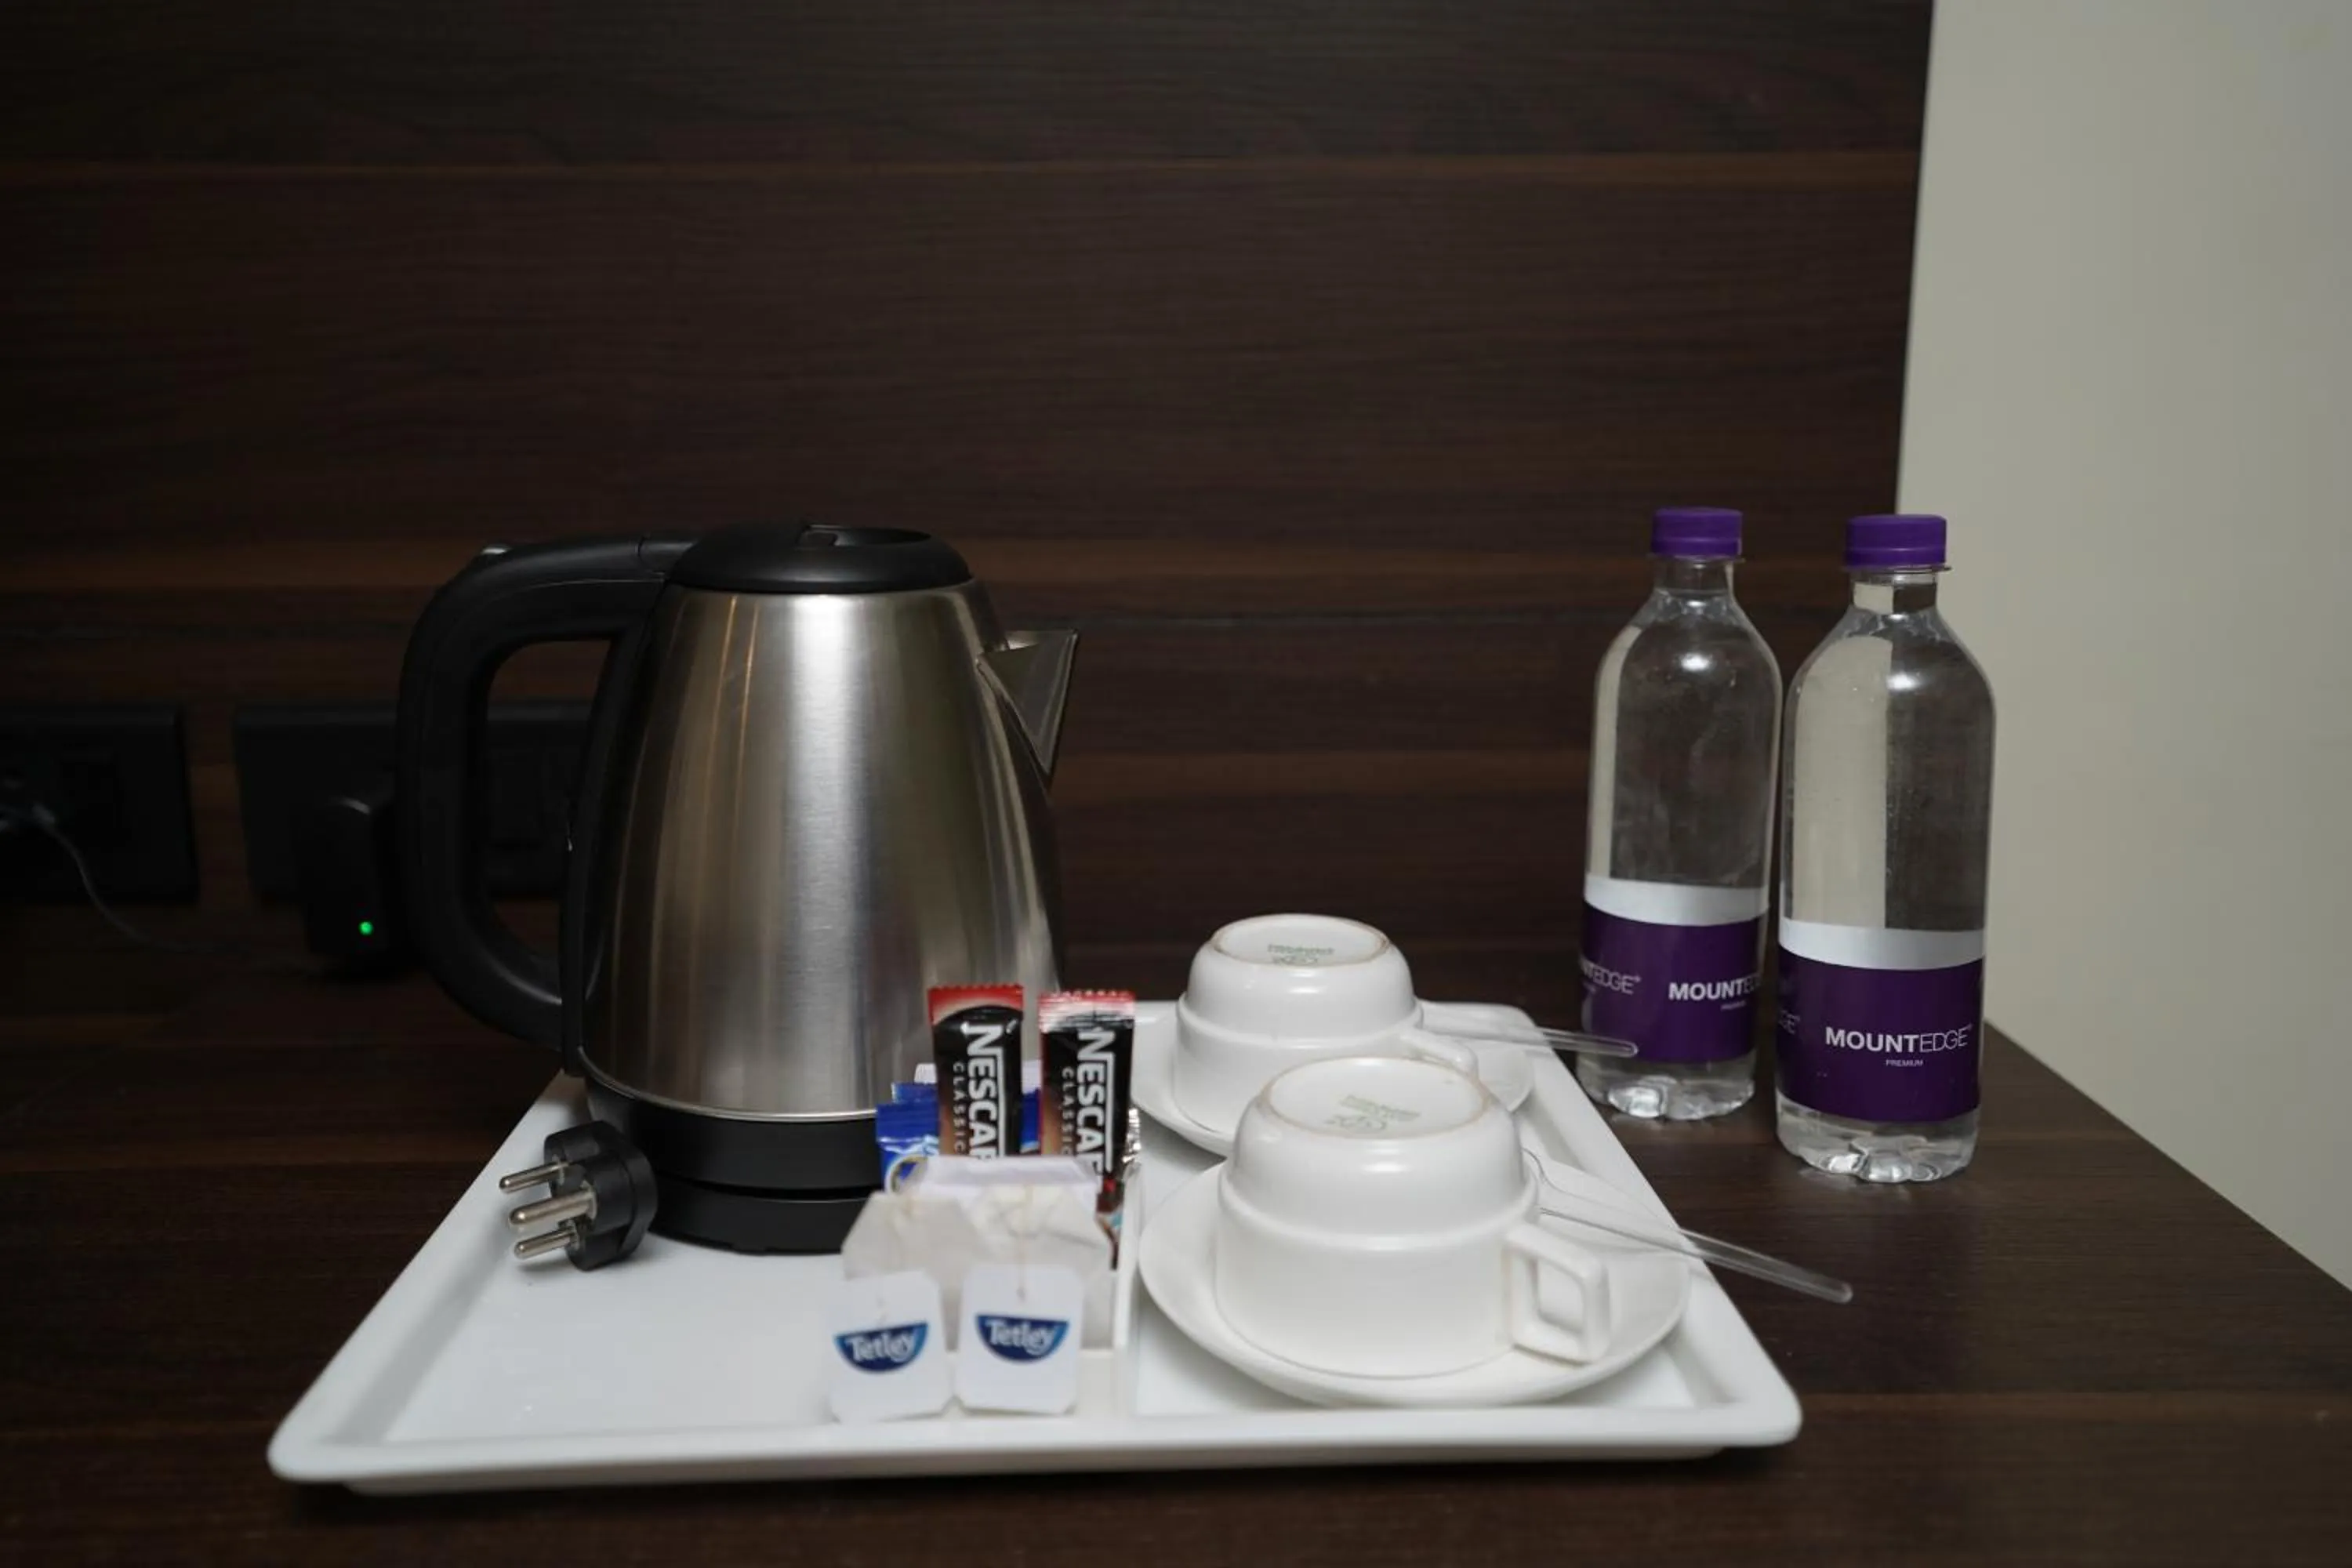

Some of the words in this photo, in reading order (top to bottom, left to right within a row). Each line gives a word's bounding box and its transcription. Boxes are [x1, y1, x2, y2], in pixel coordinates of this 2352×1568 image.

[1825, 1025, 1969, 1053] MOUNTEDGE
[1886, 1058, 1924, 1067] PREMIUM
[953, 1062, 964, 1154] CLASSIC
[962, 1022, 1005, 1160] NESCAF
[1062, 1066, 1073, 1156] CLASSIC
[1076, 1026, 1116, 1177] NESCAF
[844, 1331, 915, 1363] Tetley
[985, 1318, 1055, 1356] Tetley
